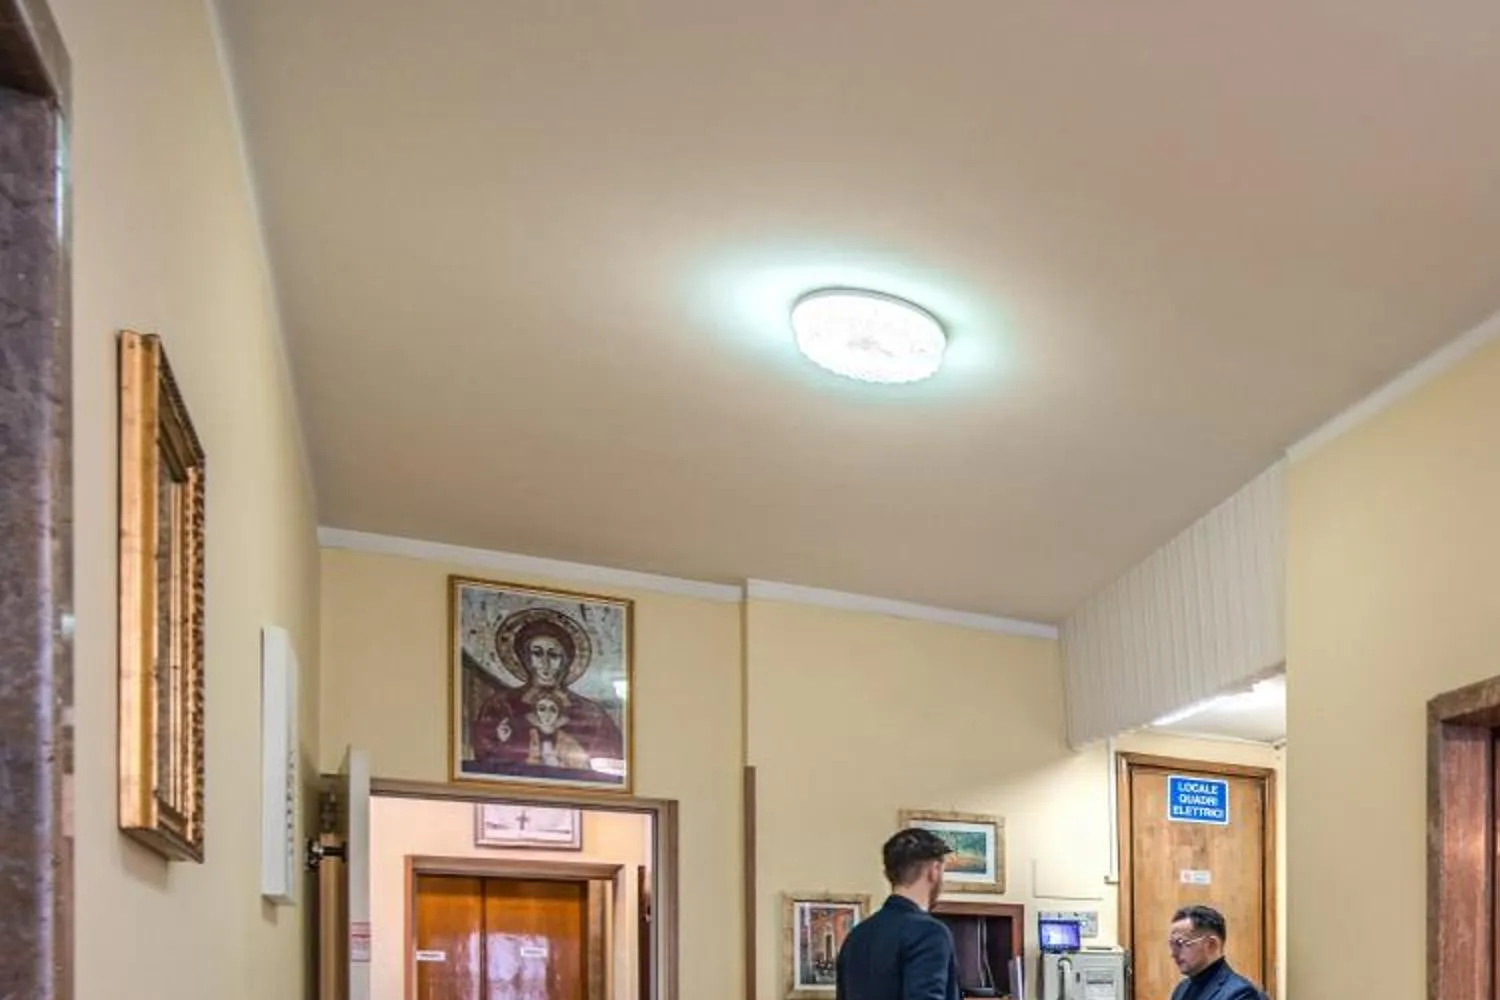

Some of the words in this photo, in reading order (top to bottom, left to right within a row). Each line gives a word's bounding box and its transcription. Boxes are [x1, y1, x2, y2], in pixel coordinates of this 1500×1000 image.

[1177, 781, 1219, 795] LOCALE
[1179, 793, 1219, 806] QUADRI
[1173, 805, 1225, 819] ELETTRICI
